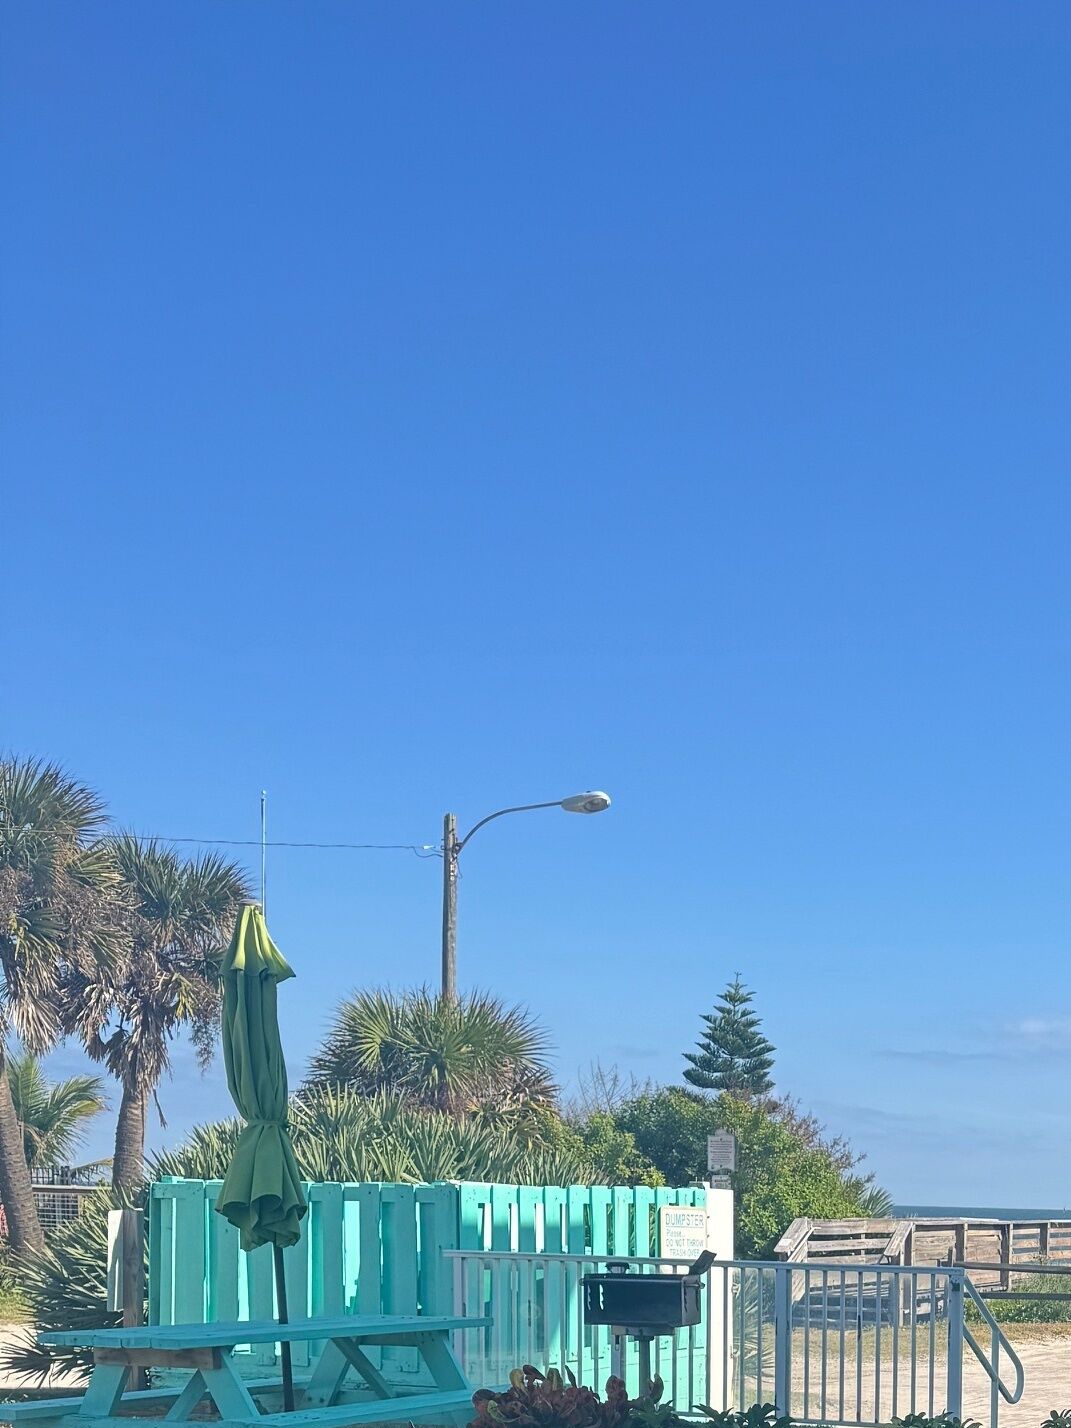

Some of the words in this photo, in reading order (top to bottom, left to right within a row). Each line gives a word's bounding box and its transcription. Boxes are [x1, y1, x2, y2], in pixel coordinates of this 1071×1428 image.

[665, 1213, 704, 1226] DUMPSTER
[665, 1239, 673, 1247] DO
[675, 1239, 685, 1247] NOT
[687, 1239, 704, 1247] THROW
[669, 1248, 686, 1257] TRASH
